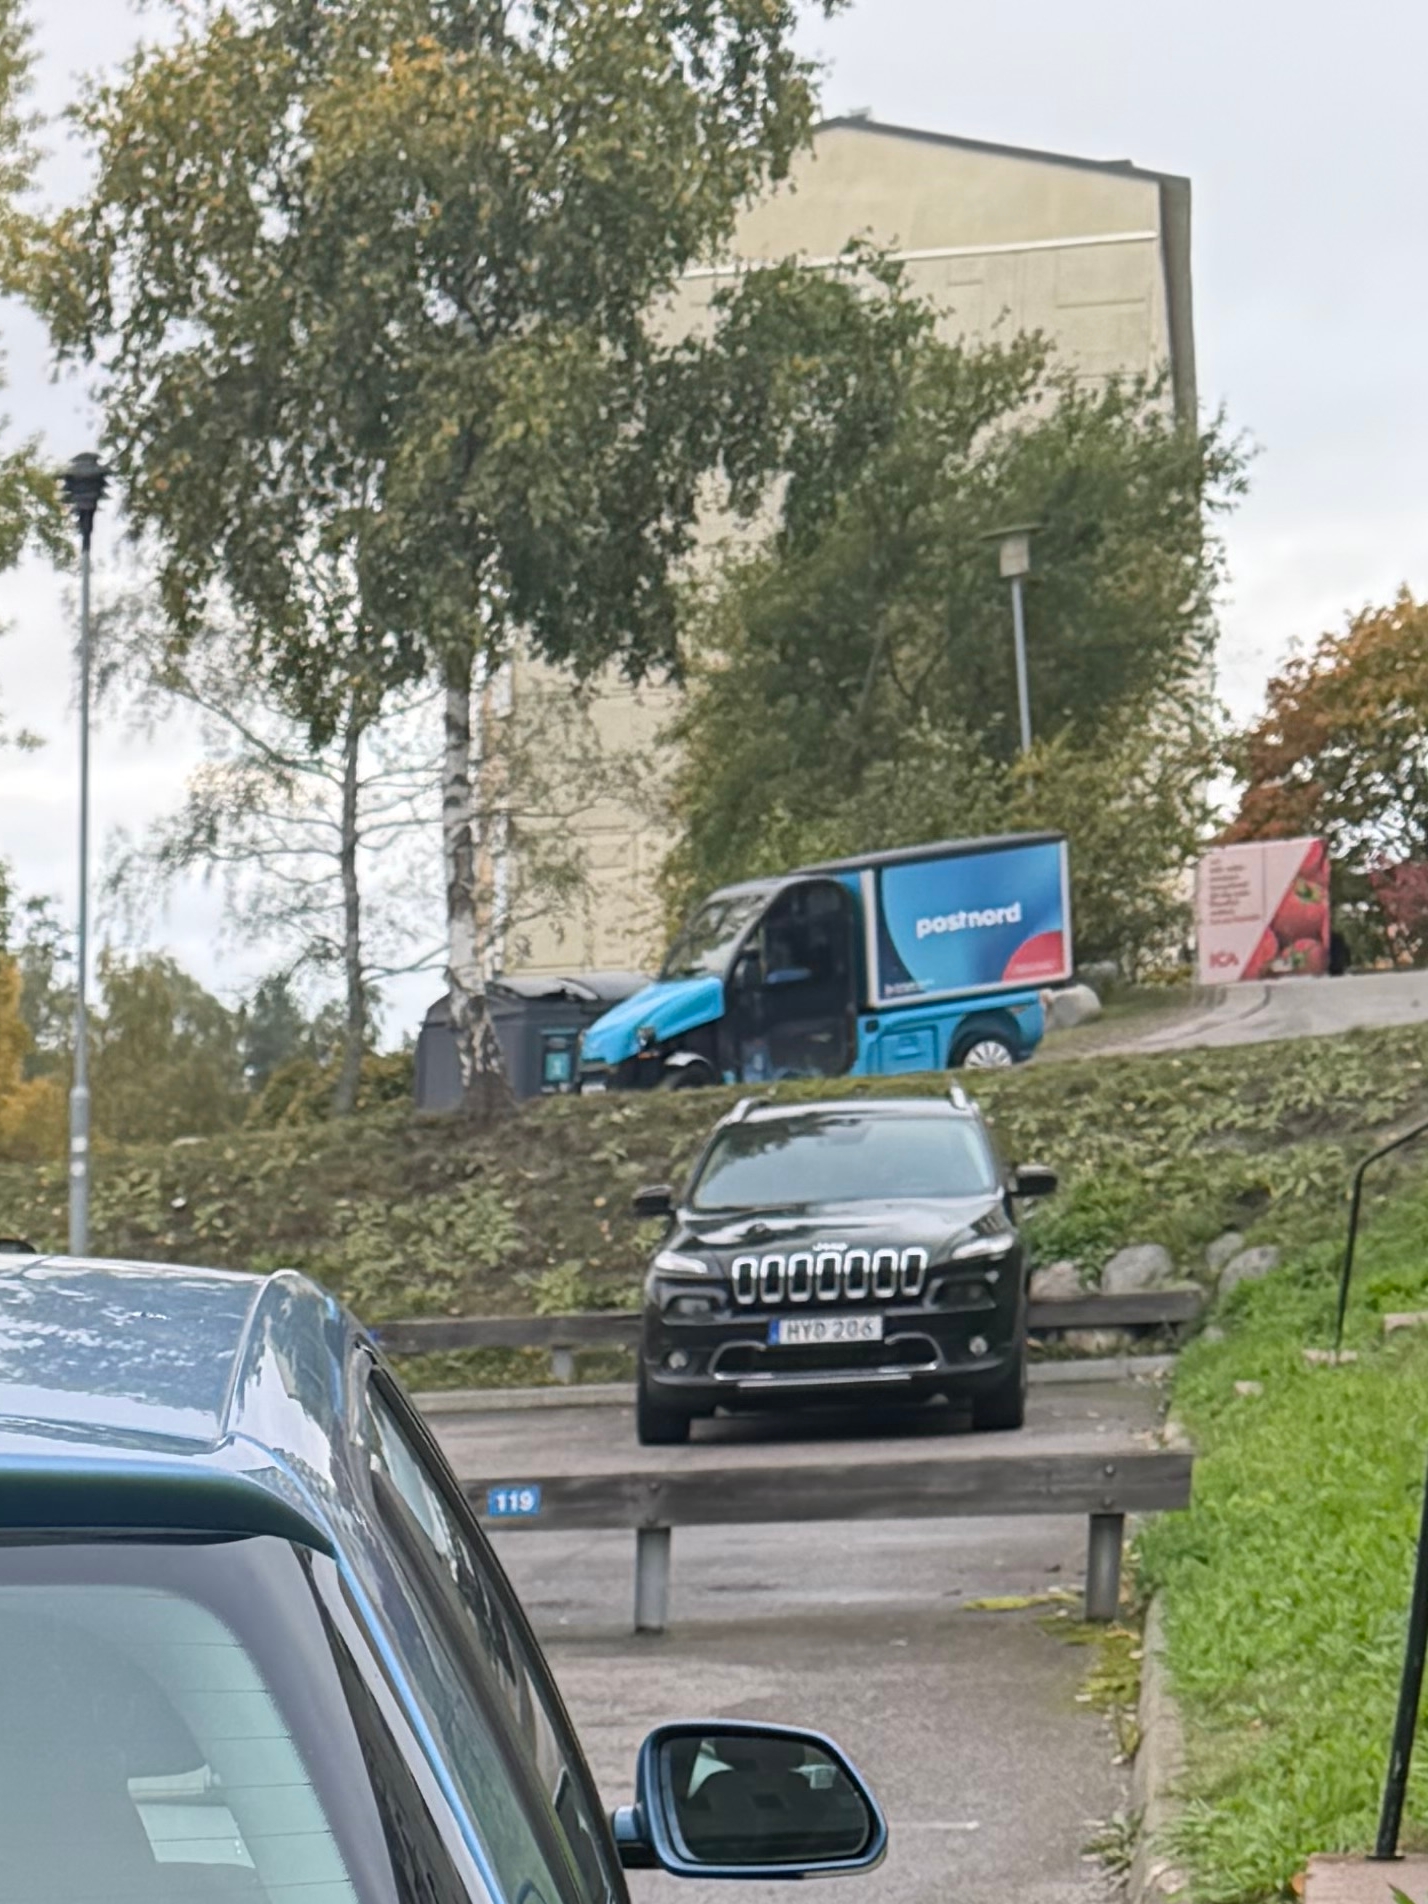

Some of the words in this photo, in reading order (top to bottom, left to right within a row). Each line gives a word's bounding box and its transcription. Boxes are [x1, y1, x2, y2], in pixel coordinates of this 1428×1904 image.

[916, 902, 1022, 939] postnord
[1209, 950, 1239, 968] ICA
[496, 1490, 535, 1512] 119
